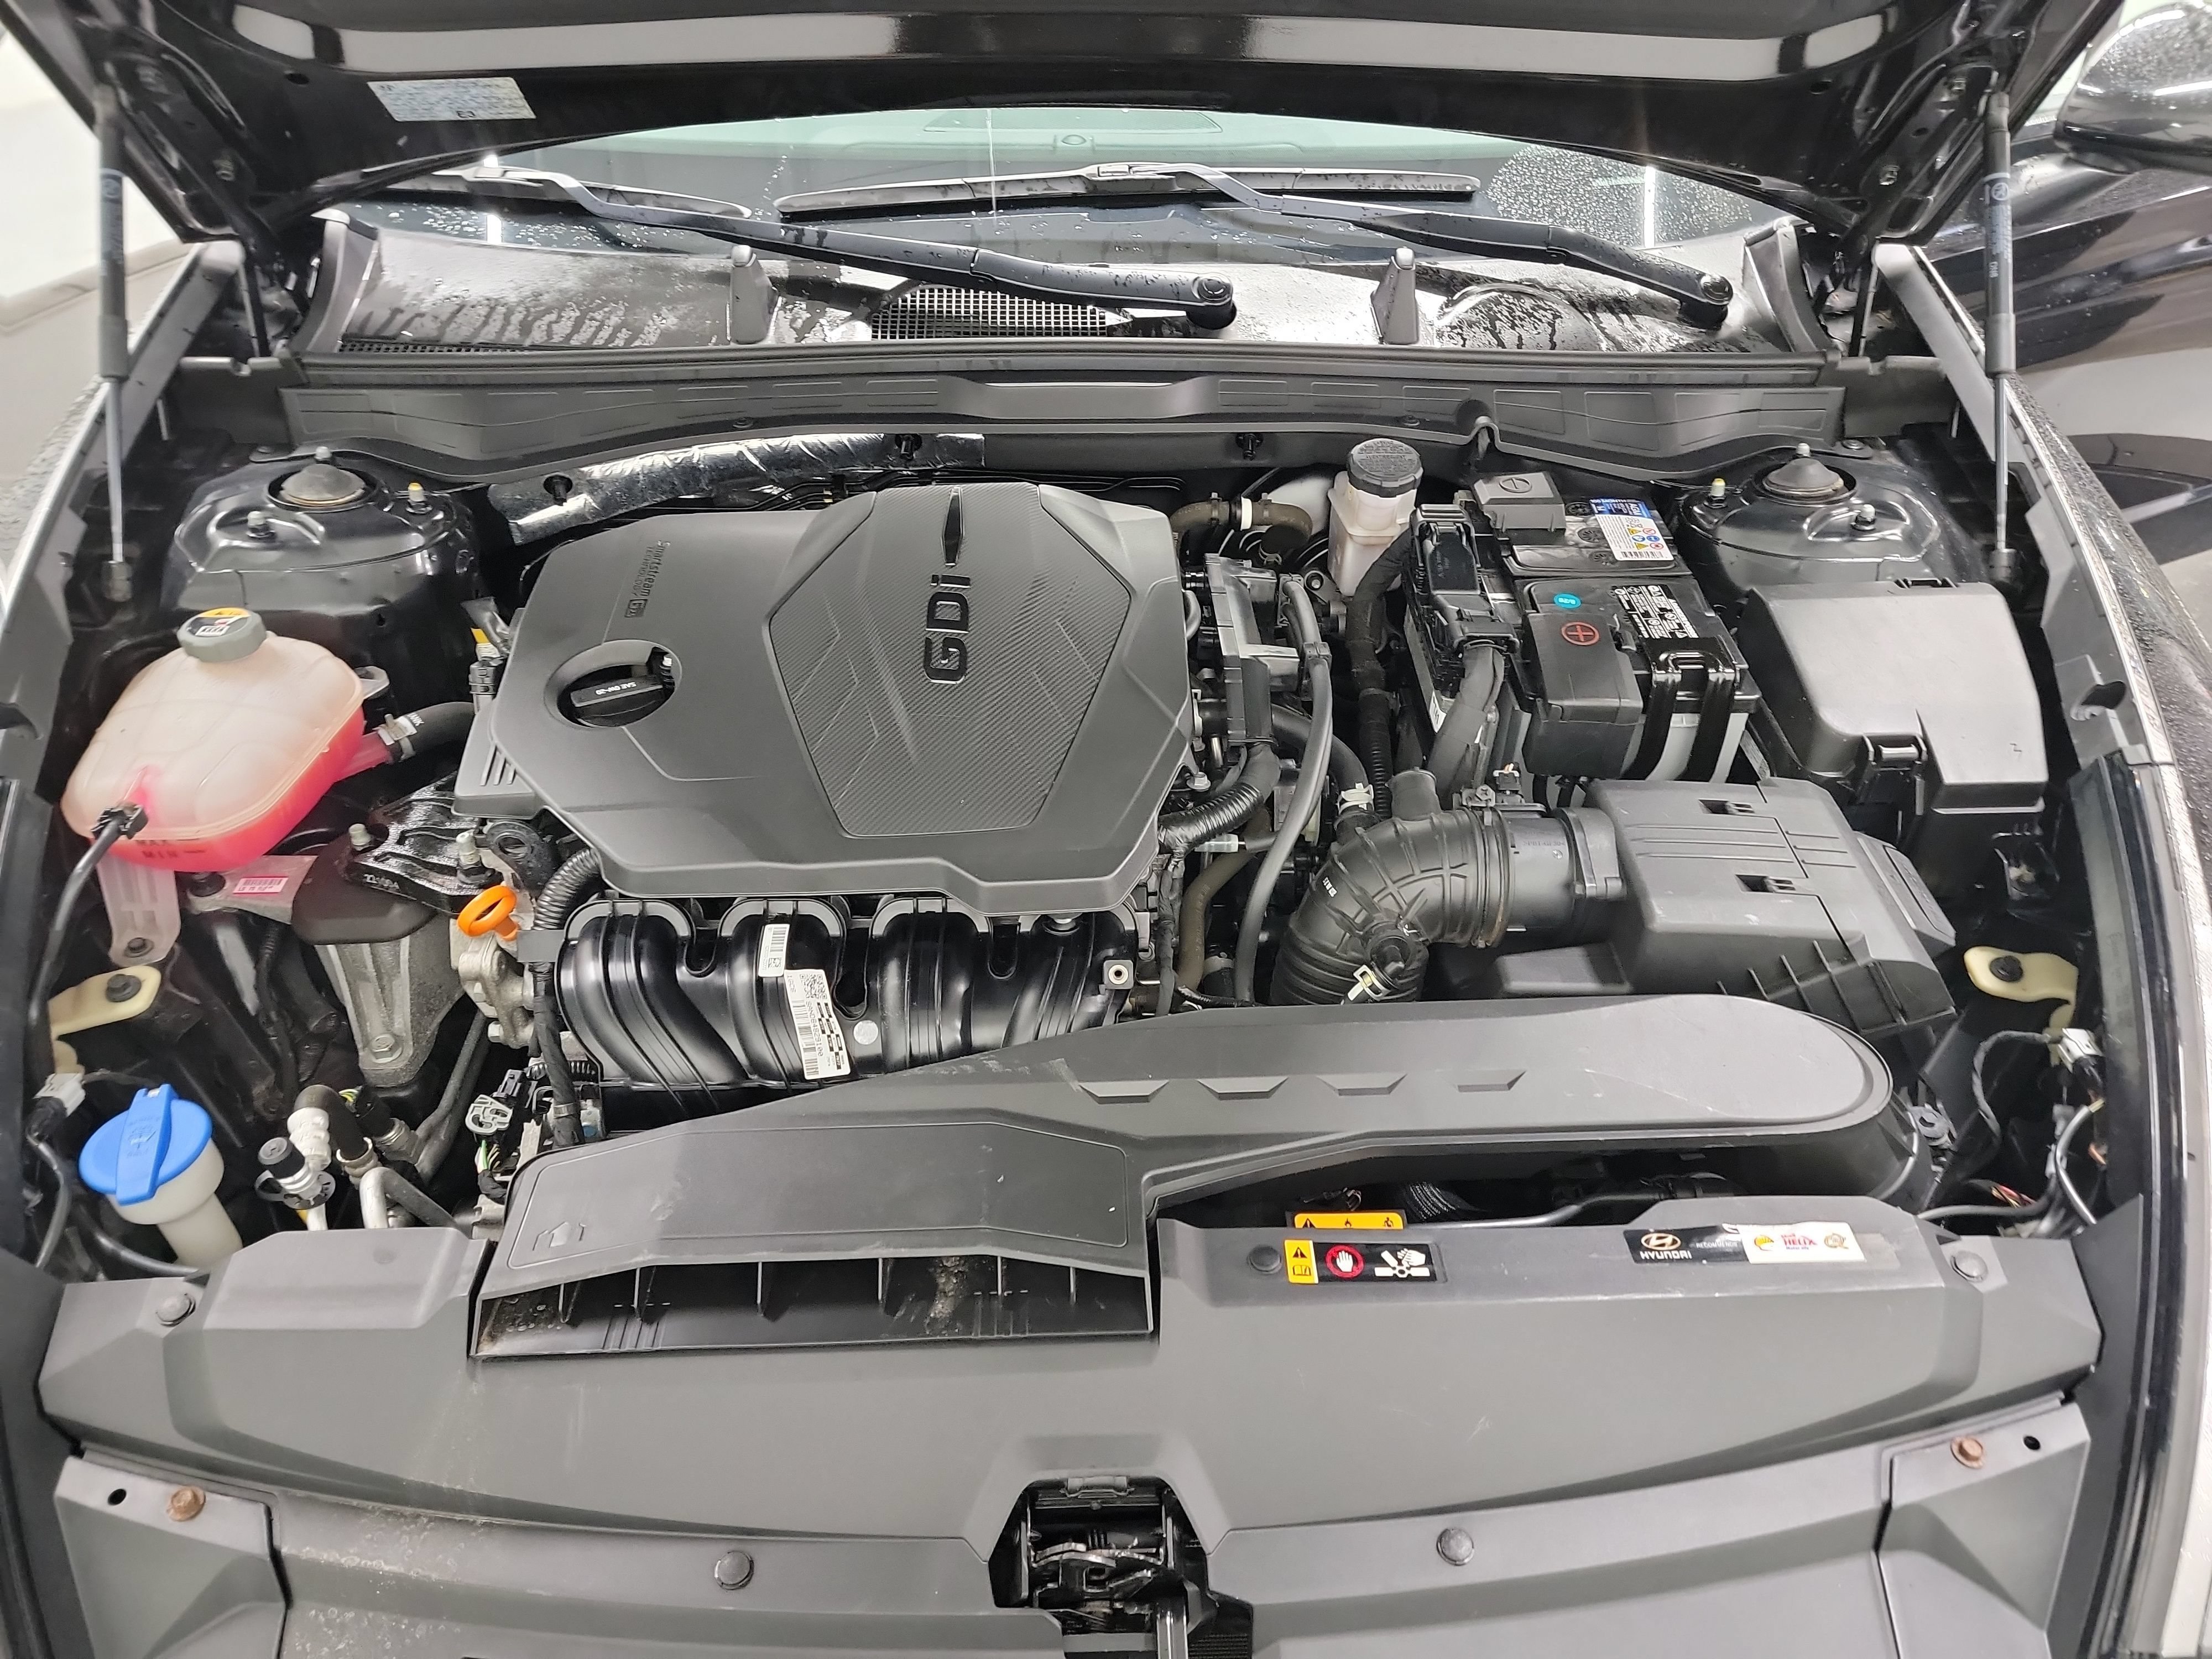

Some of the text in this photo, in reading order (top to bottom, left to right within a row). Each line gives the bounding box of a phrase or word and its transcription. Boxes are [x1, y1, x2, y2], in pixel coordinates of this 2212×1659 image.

[640, 540, 671, 597] Smartstream
[924, 574, 971, 685] GDi
[1639, 1250, 1693, 1260] HYUNDAI
